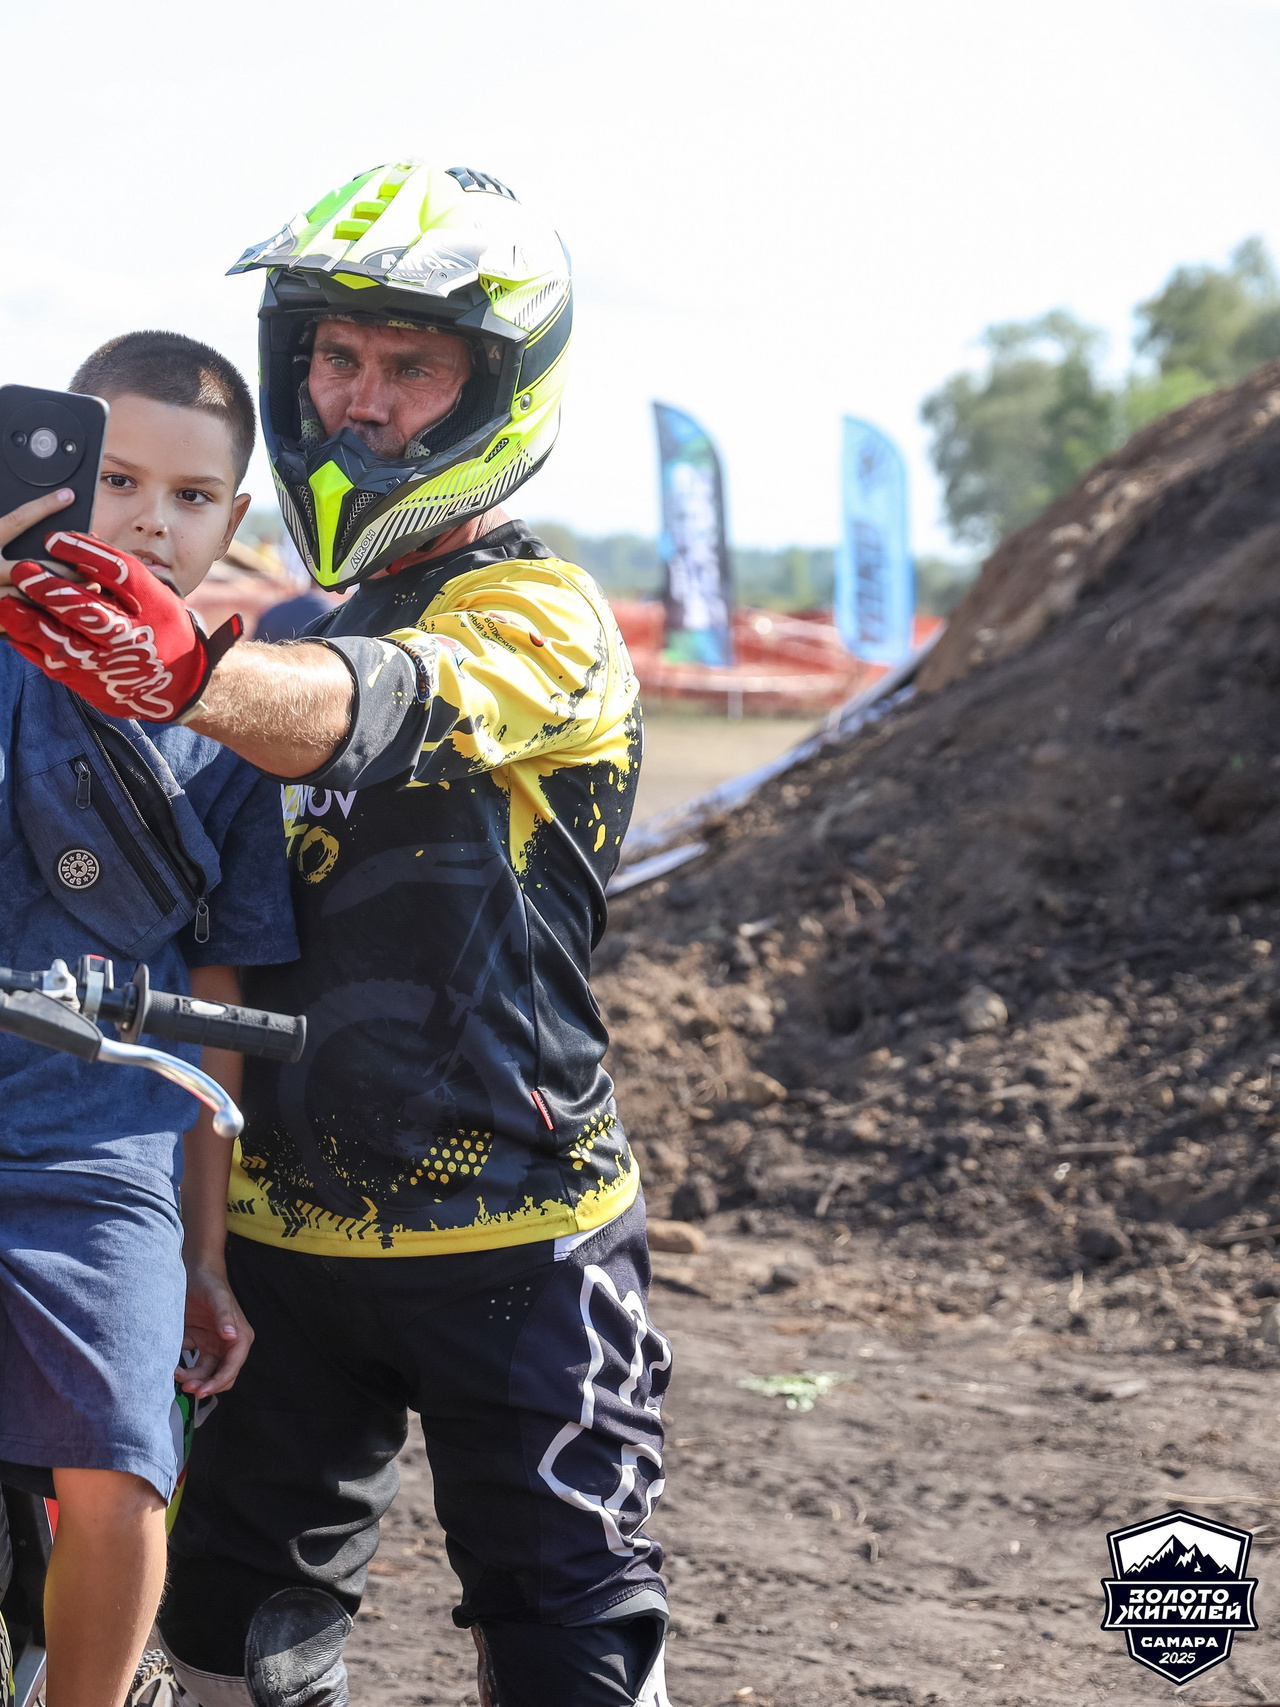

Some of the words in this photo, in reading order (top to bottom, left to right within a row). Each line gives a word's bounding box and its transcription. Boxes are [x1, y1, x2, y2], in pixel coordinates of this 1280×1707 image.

[484, 617, 517, 653] ВОЛЖСКИЙ
[62, 859, 82, 886] SPORT
[75, 852, 95, 879] SPORT
